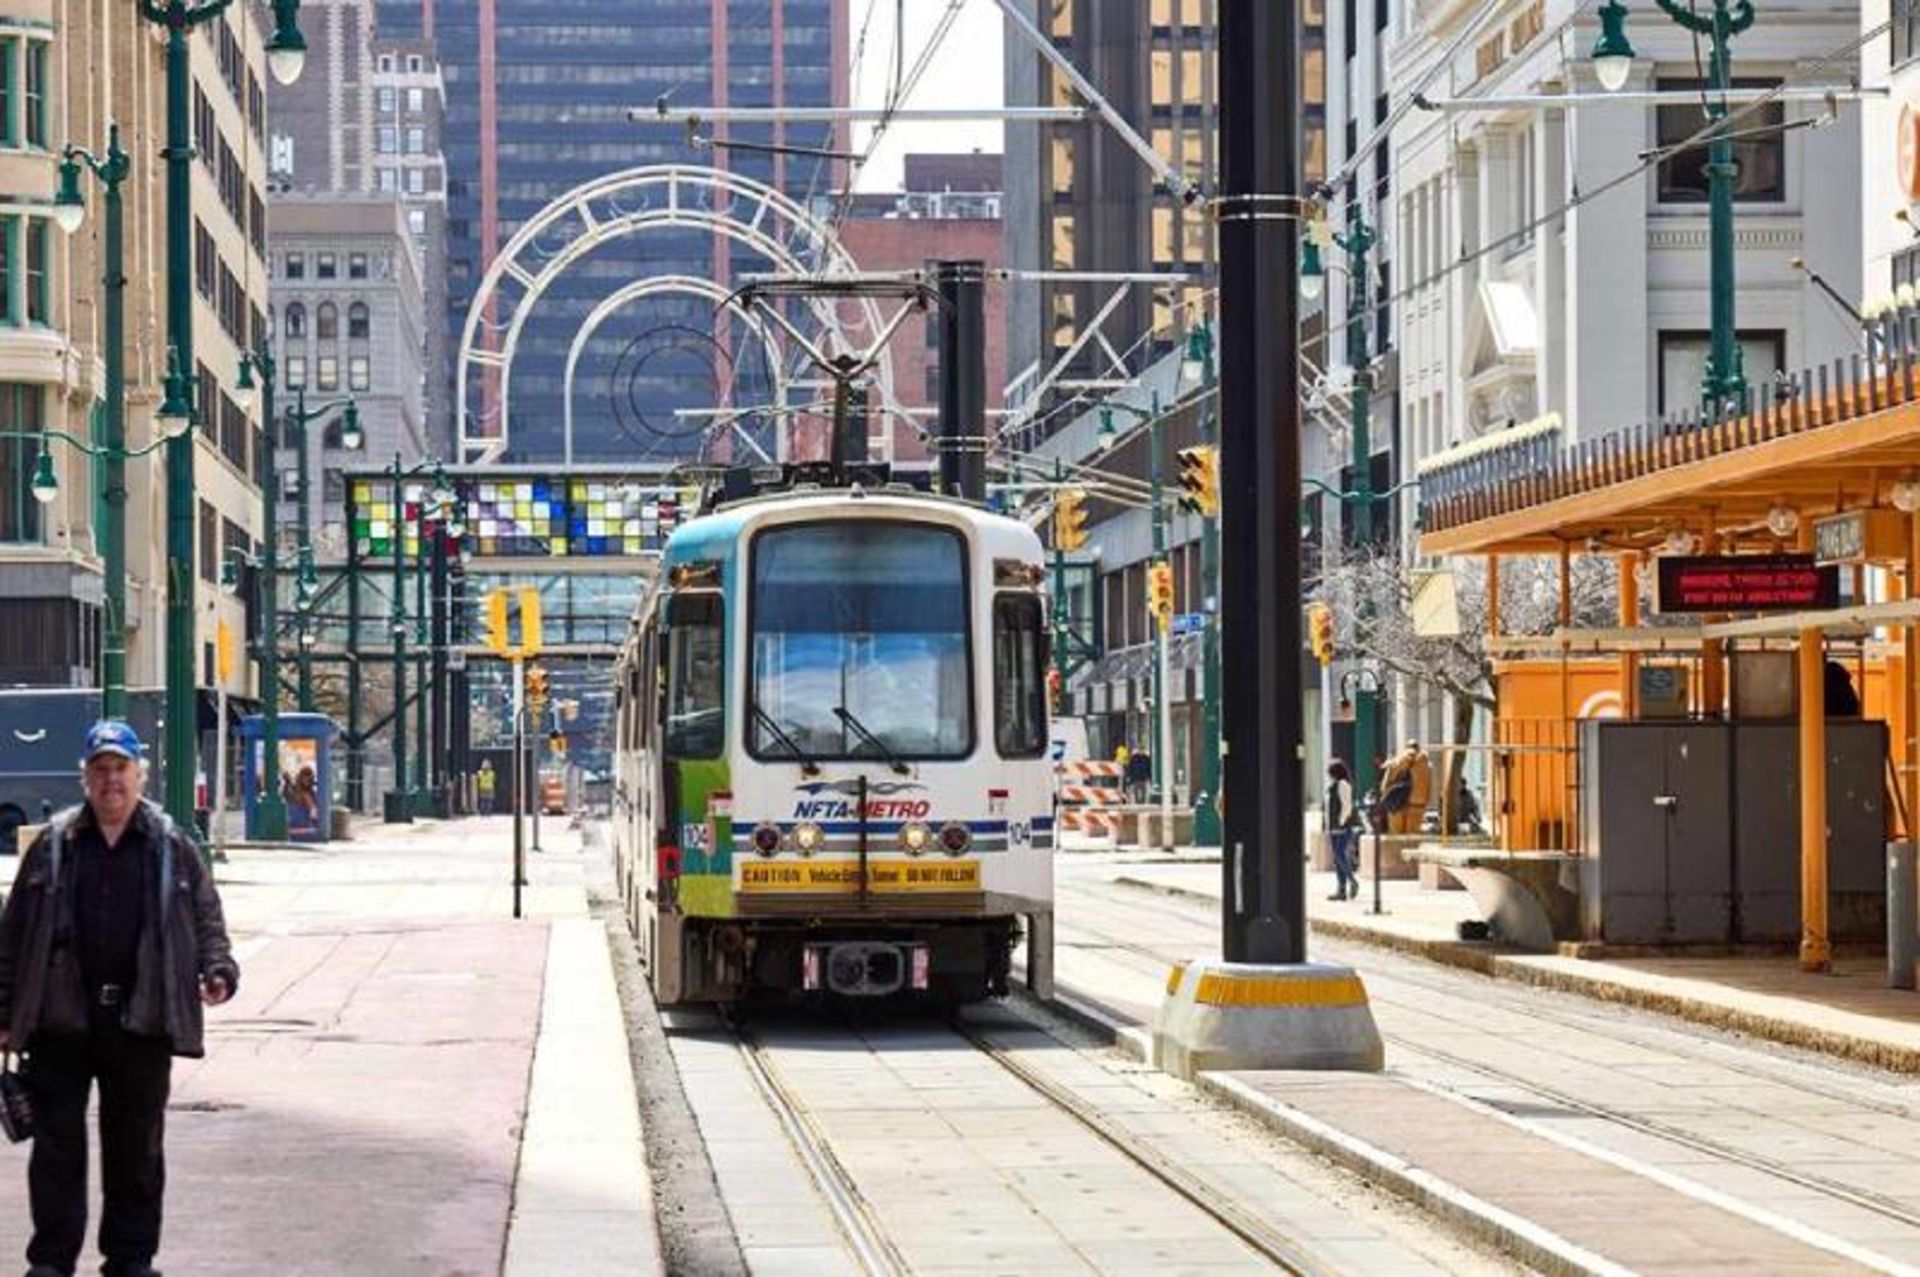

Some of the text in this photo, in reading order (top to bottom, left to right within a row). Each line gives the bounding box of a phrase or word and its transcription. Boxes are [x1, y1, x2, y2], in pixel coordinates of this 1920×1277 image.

[793, 799, 931, 818] NFTA-METRO
[1009, 822, 1031, 845] 104
[742, 868, 801, 882] CAUTION
[920, 868, 939, 882] NOT
[940, 868, 975, 882] FOLLOW
